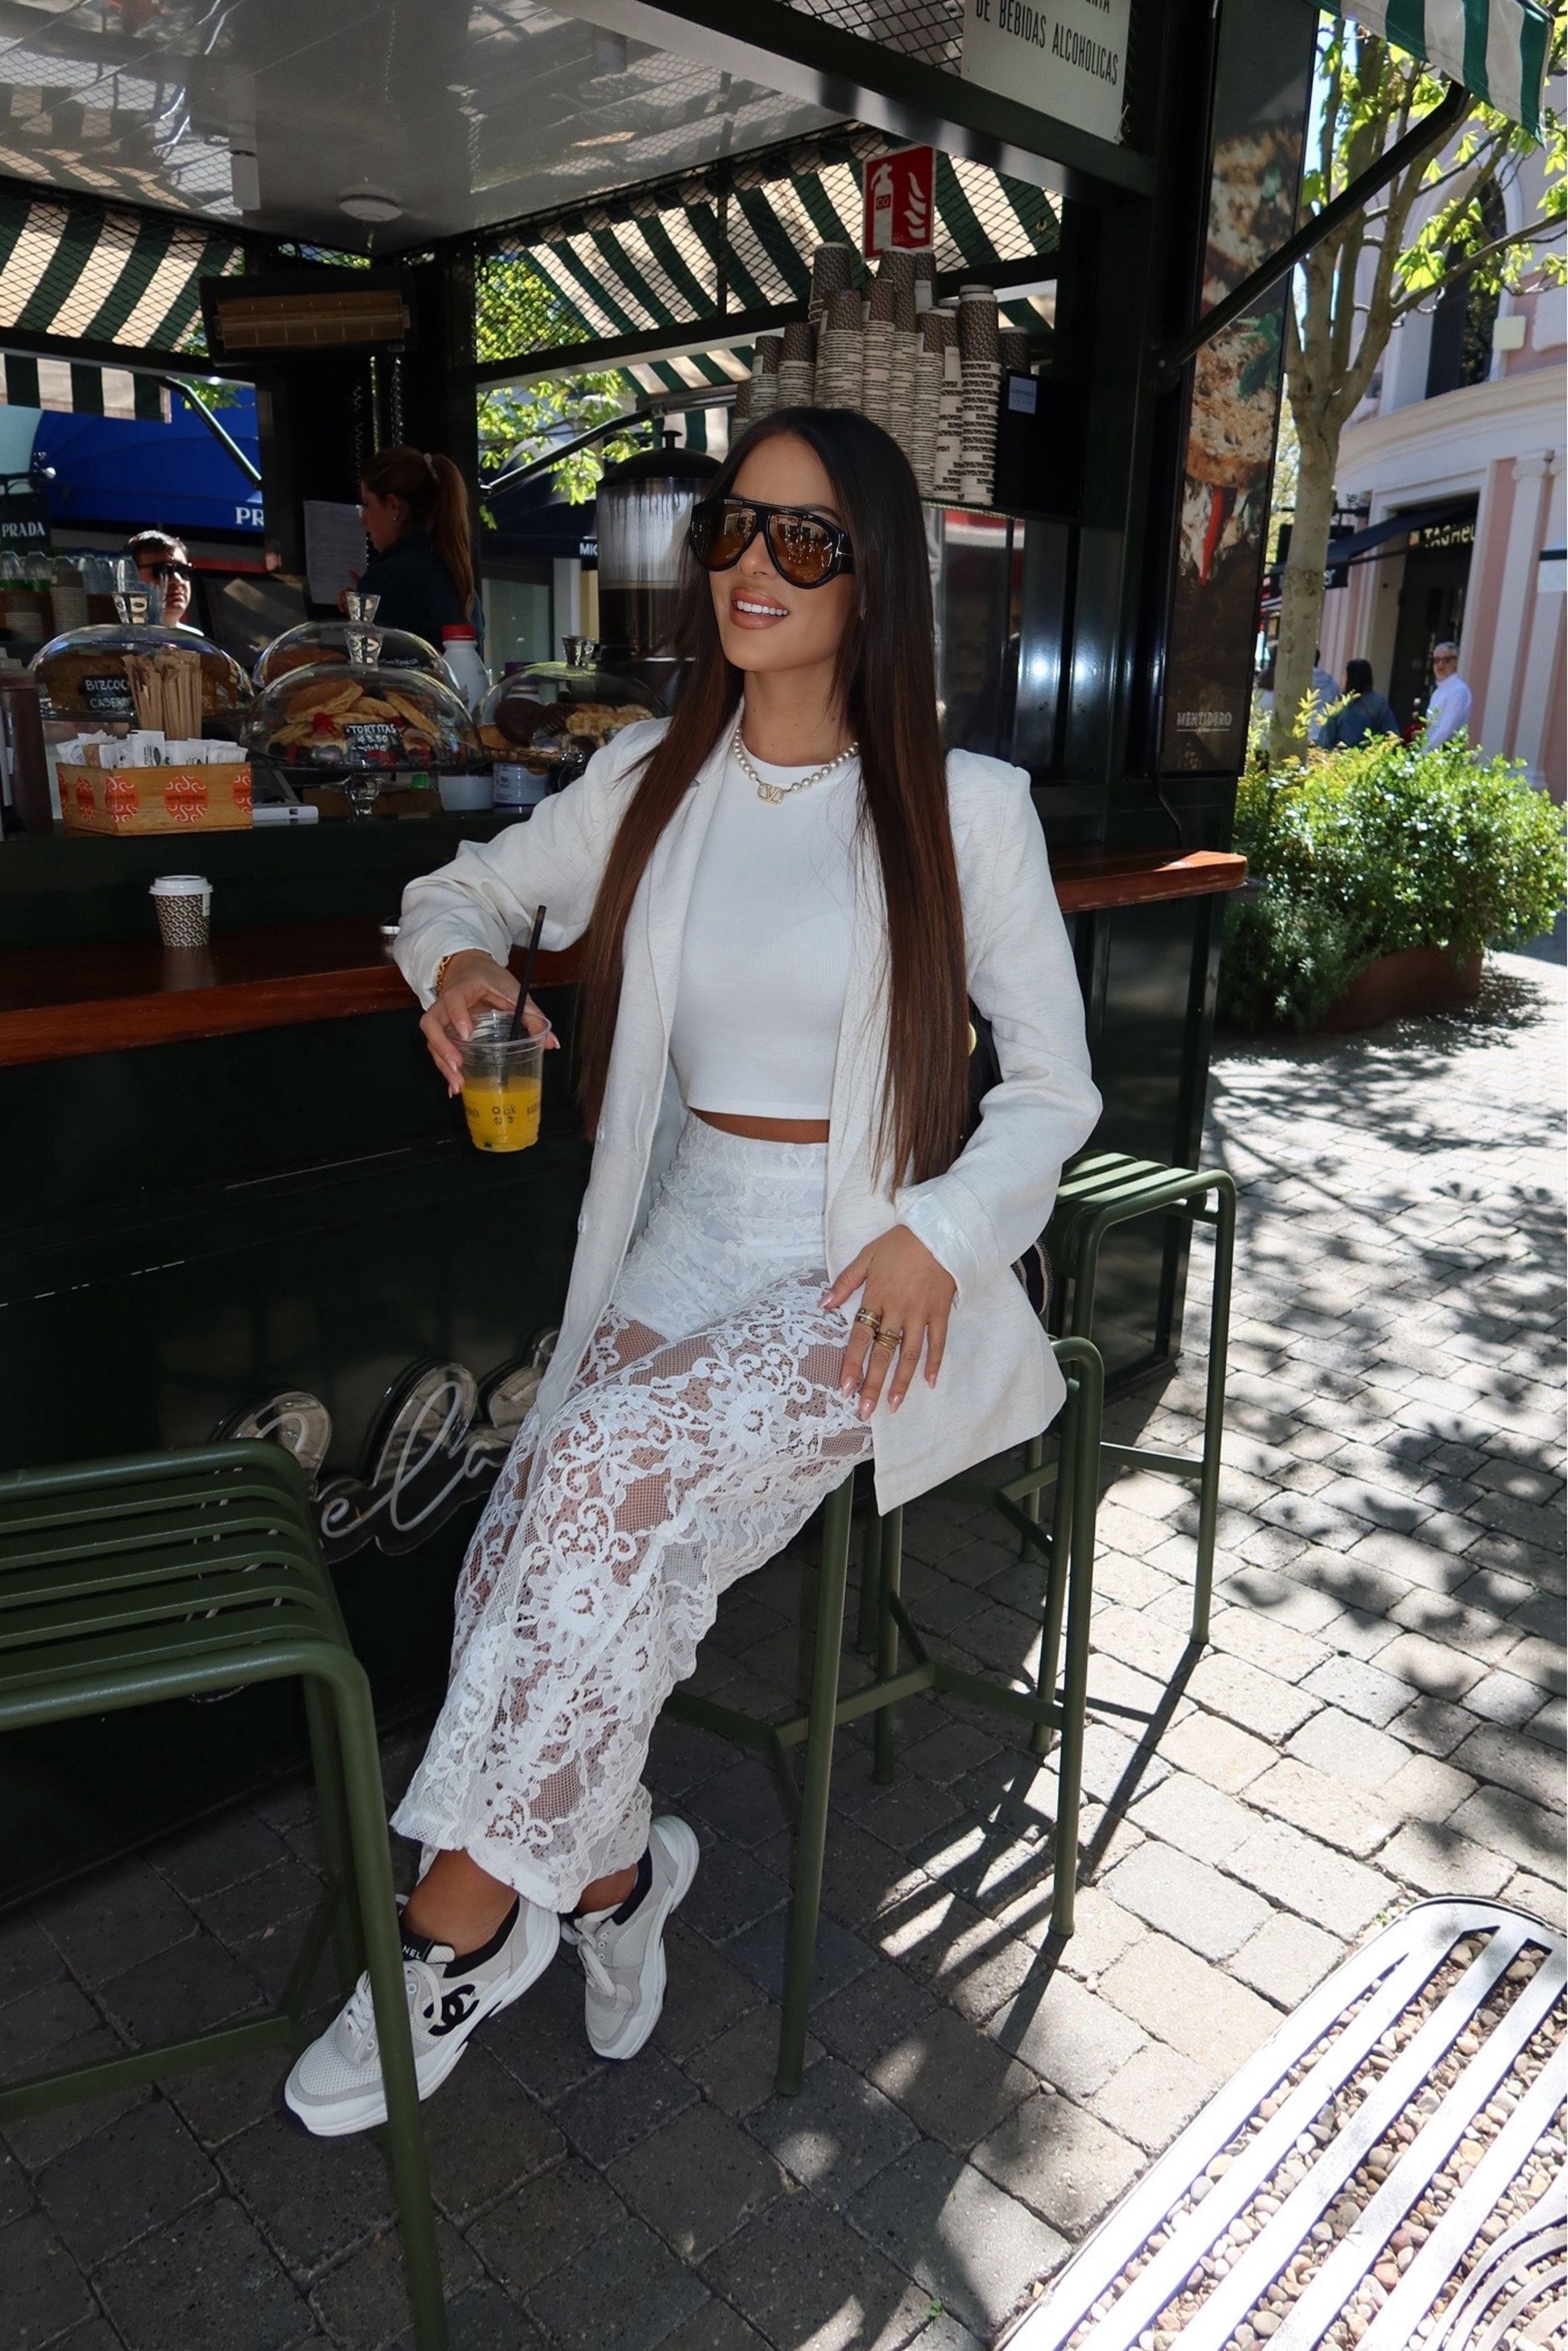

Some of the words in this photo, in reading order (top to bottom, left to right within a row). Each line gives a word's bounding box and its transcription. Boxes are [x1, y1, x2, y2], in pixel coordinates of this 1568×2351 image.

[999, 0, 1046, 48] BEBIDAS
[1052, 23, 1118, 85] ALCOHOLICAS
[2, 521, 45, 537] PRADA
[1177, 711, 1232, 726] MENTIDERO
[348, 724, 396, 734] TORTITAS
